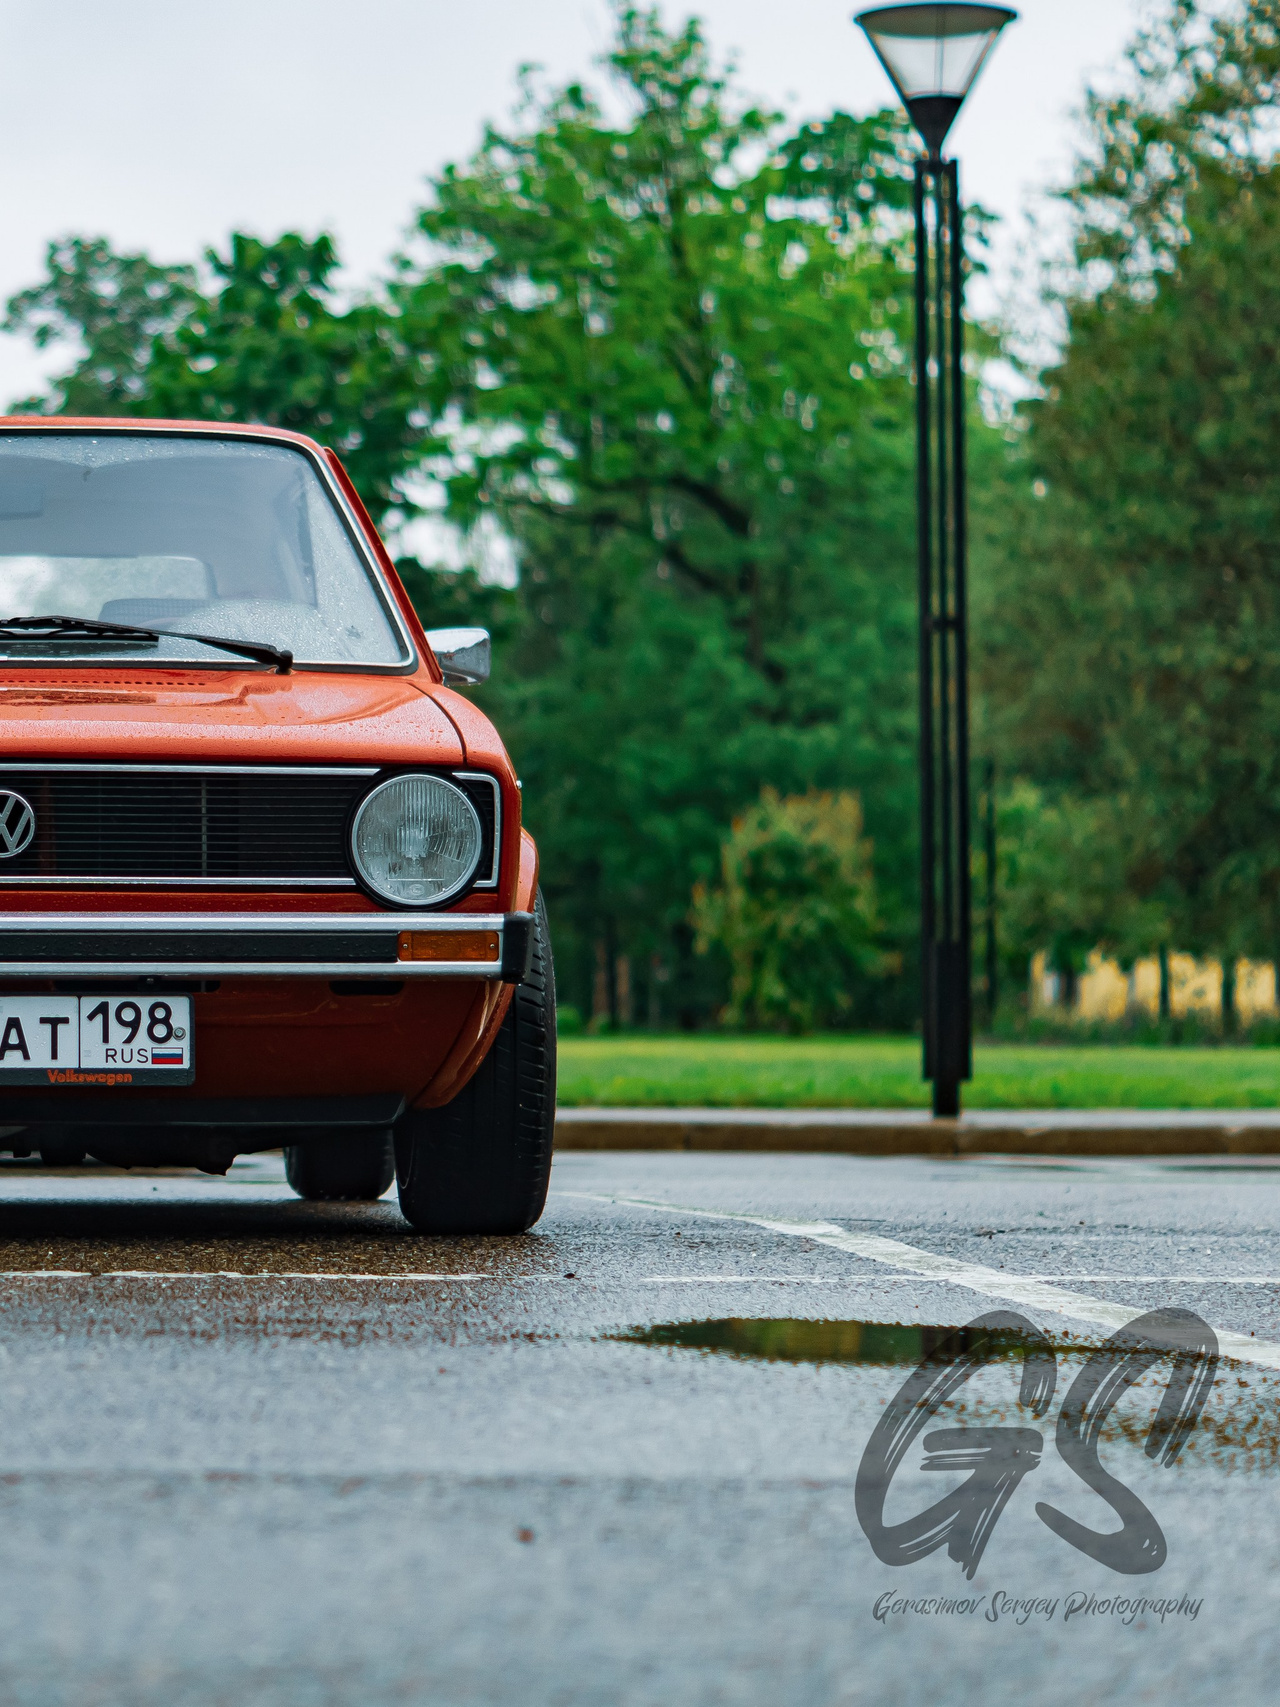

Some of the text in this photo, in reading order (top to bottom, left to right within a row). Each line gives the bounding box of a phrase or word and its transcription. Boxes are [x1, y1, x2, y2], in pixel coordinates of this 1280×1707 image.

[86, 1001, 173, 1044] 198
[105, 1047, 149, 1064] RUS
[47, 1069, 132, 1085] Volkswagen
